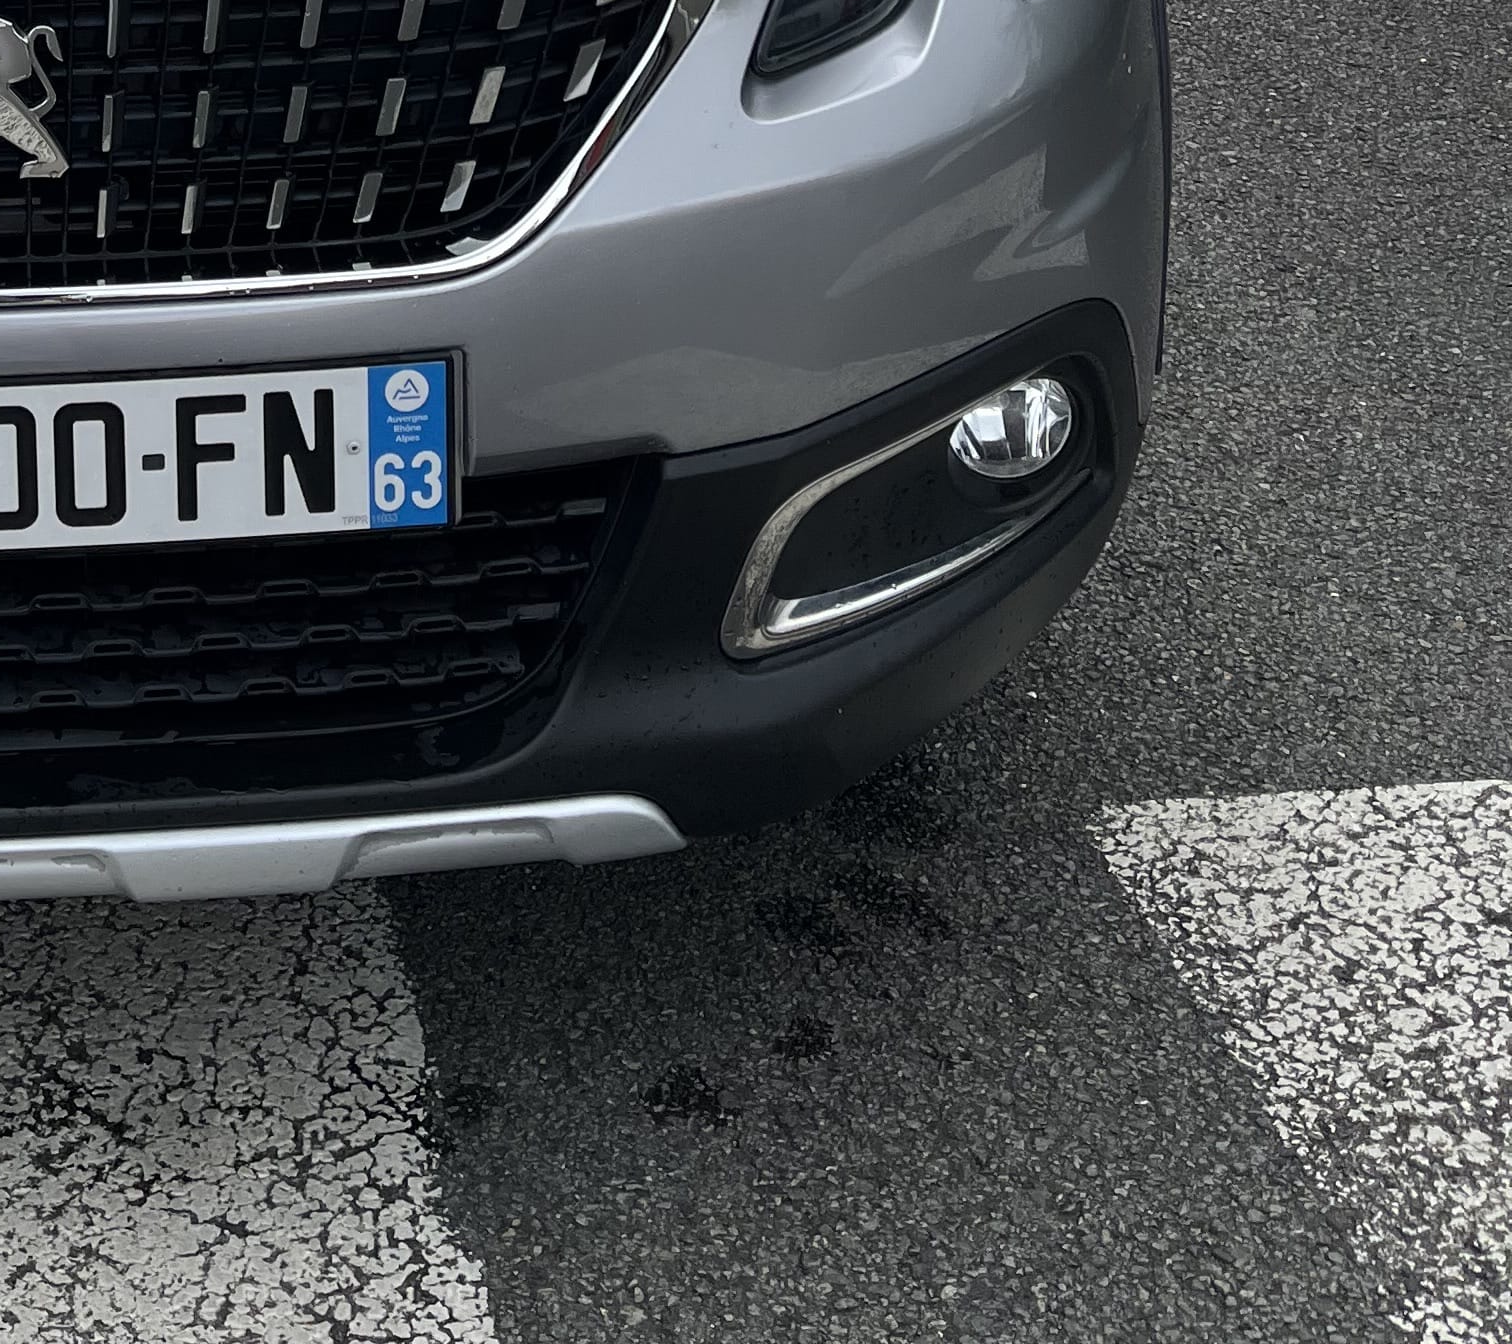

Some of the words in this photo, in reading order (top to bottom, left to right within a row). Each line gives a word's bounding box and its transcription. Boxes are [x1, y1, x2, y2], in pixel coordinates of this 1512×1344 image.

[386, 414, 429, 424] Auvergne
[393, 423, 422, 433] Rhône
[395, 433, 421, 443] Alpes
[374, 450, 442, 512] 63
